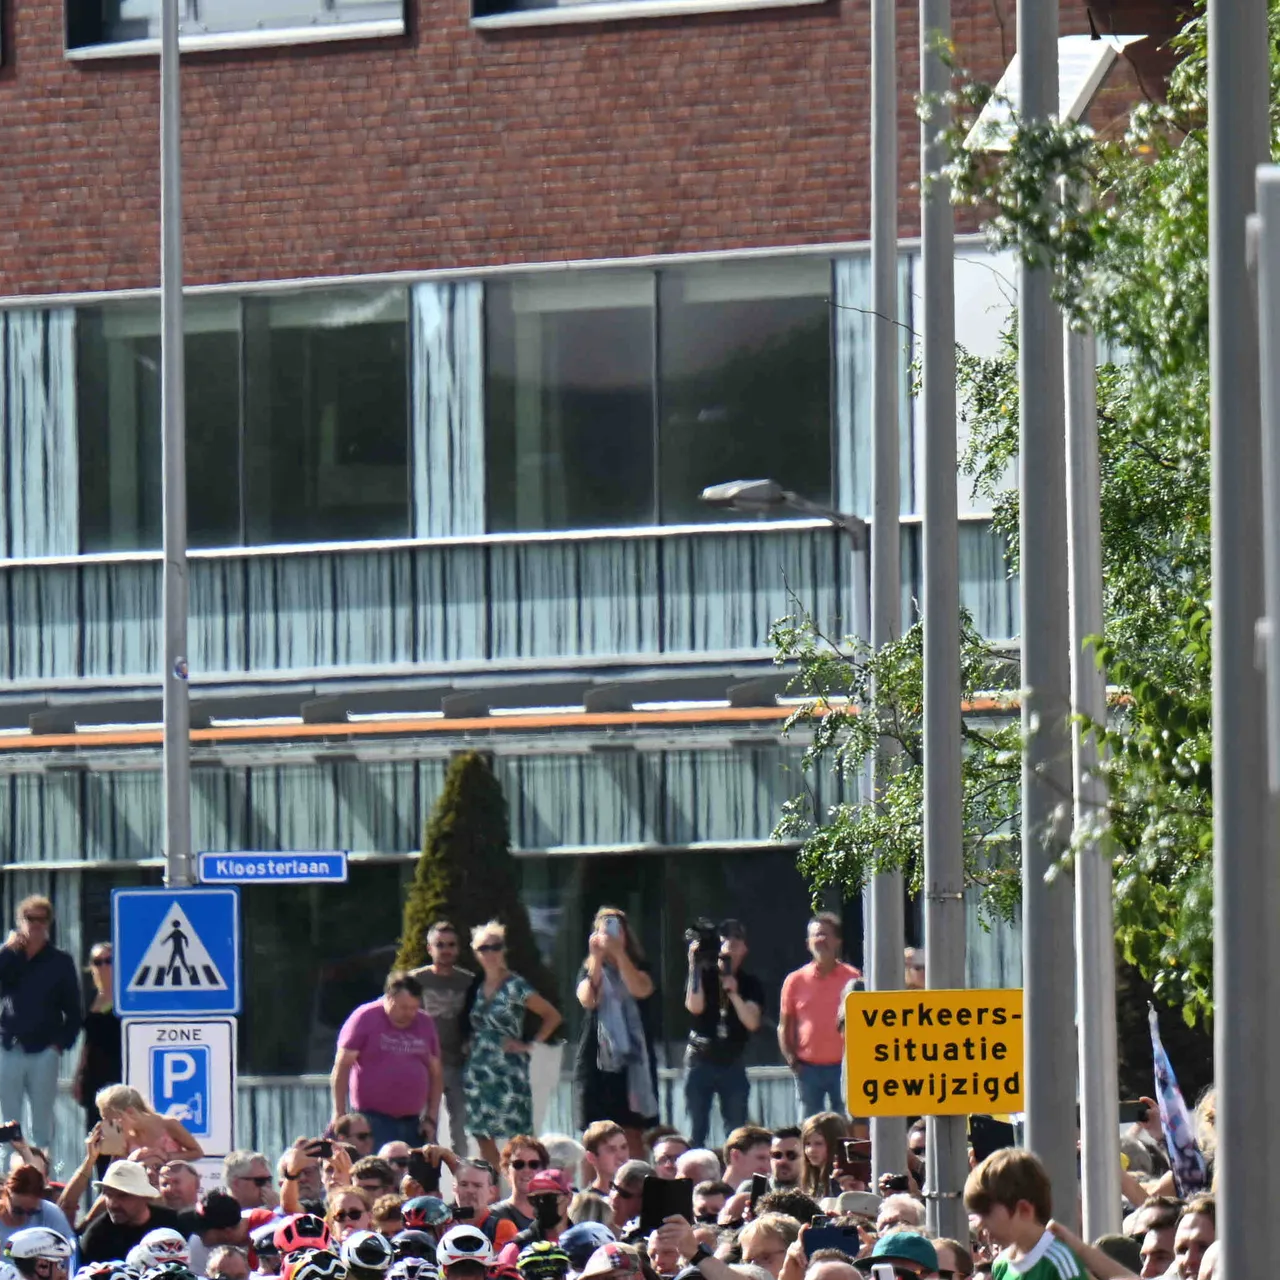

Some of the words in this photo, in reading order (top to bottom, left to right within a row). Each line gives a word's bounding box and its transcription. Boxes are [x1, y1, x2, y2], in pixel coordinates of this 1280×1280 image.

[216, 859, 330, 875] Kloosterlaan
[861, 1002, 1023, 1027] verkeers-
[155, 1028, 202, 1042] ZONE
[874, 1036, 1008, 1062] situatie
[163, 1052, 197, 1098] P
[862, 1071, 1020, 1105] gewijzigd
